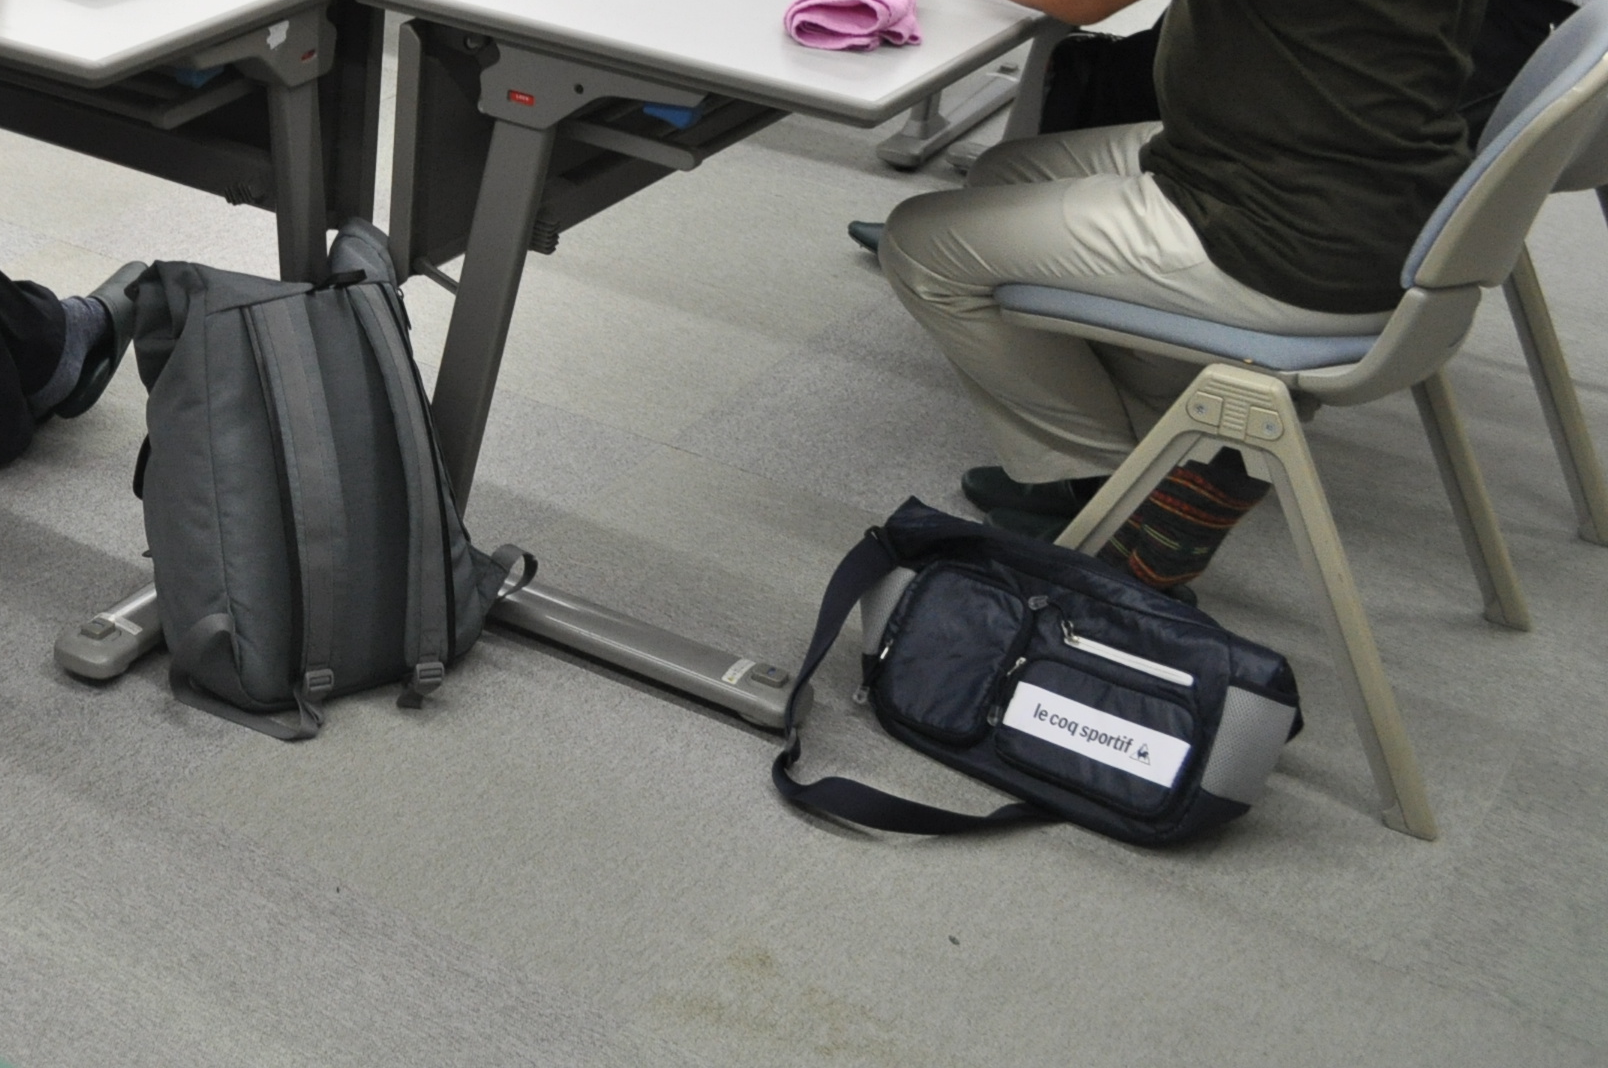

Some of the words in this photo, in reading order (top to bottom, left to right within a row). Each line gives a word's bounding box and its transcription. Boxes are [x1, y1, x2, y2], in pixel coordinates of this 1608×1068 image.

[1033, 703, 1049, 722] le
[1049, 713, 1079, 737] coq
[1079, 725, 1134, 754] sportif
